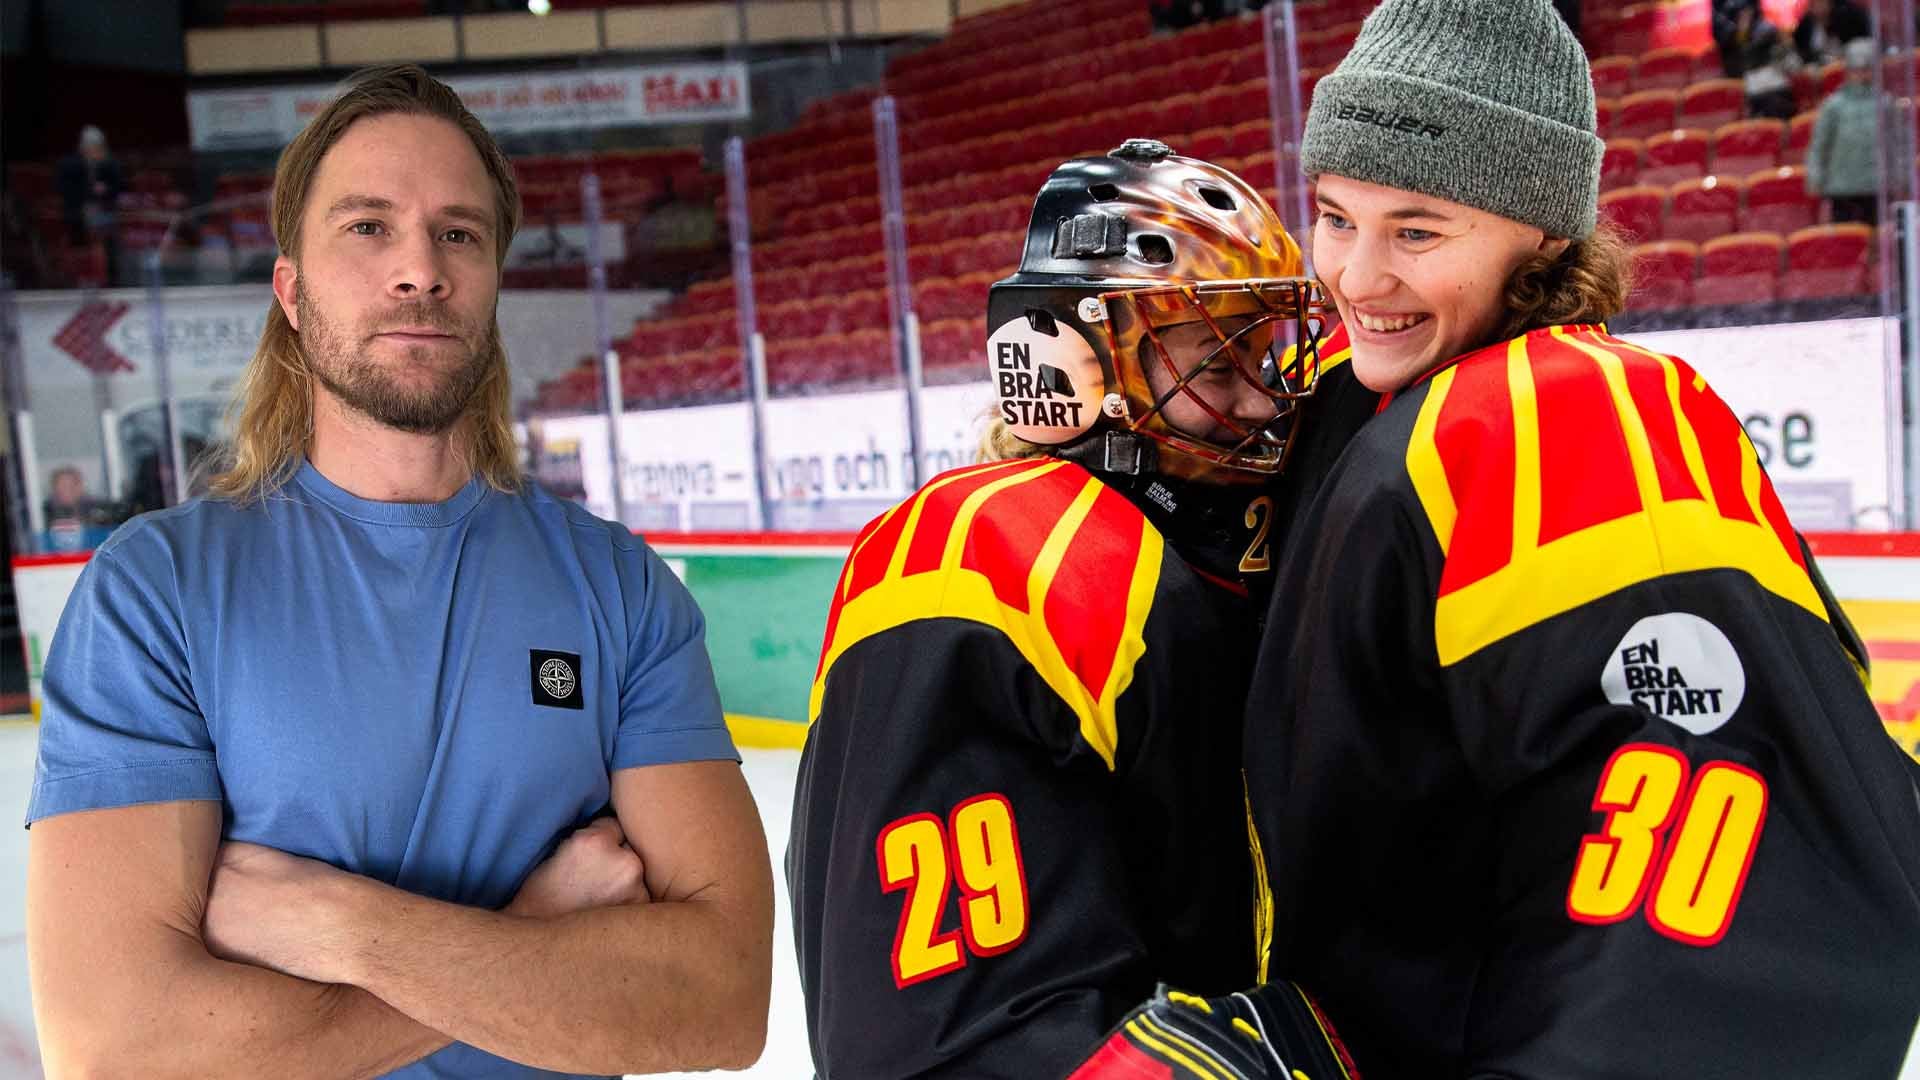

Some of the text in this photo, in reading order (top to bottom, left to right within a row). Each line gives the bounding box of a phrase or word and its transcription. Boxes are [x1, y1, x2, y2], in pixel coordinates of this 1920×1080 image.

[997, 342, 1031, 370] EN
[999, 371, 1054, 400] BRA
[1001, 400, 1084, 428] START
[1239, 496, 1273, 572] 2
[1621, 638, 1660, 665] EN
[1624, 666, 1688, 690] BRA
[1630, 688, 1723, 716] START
[1566, 742, 1769, 948] 30
[876, 792, 1030, 991] 29
